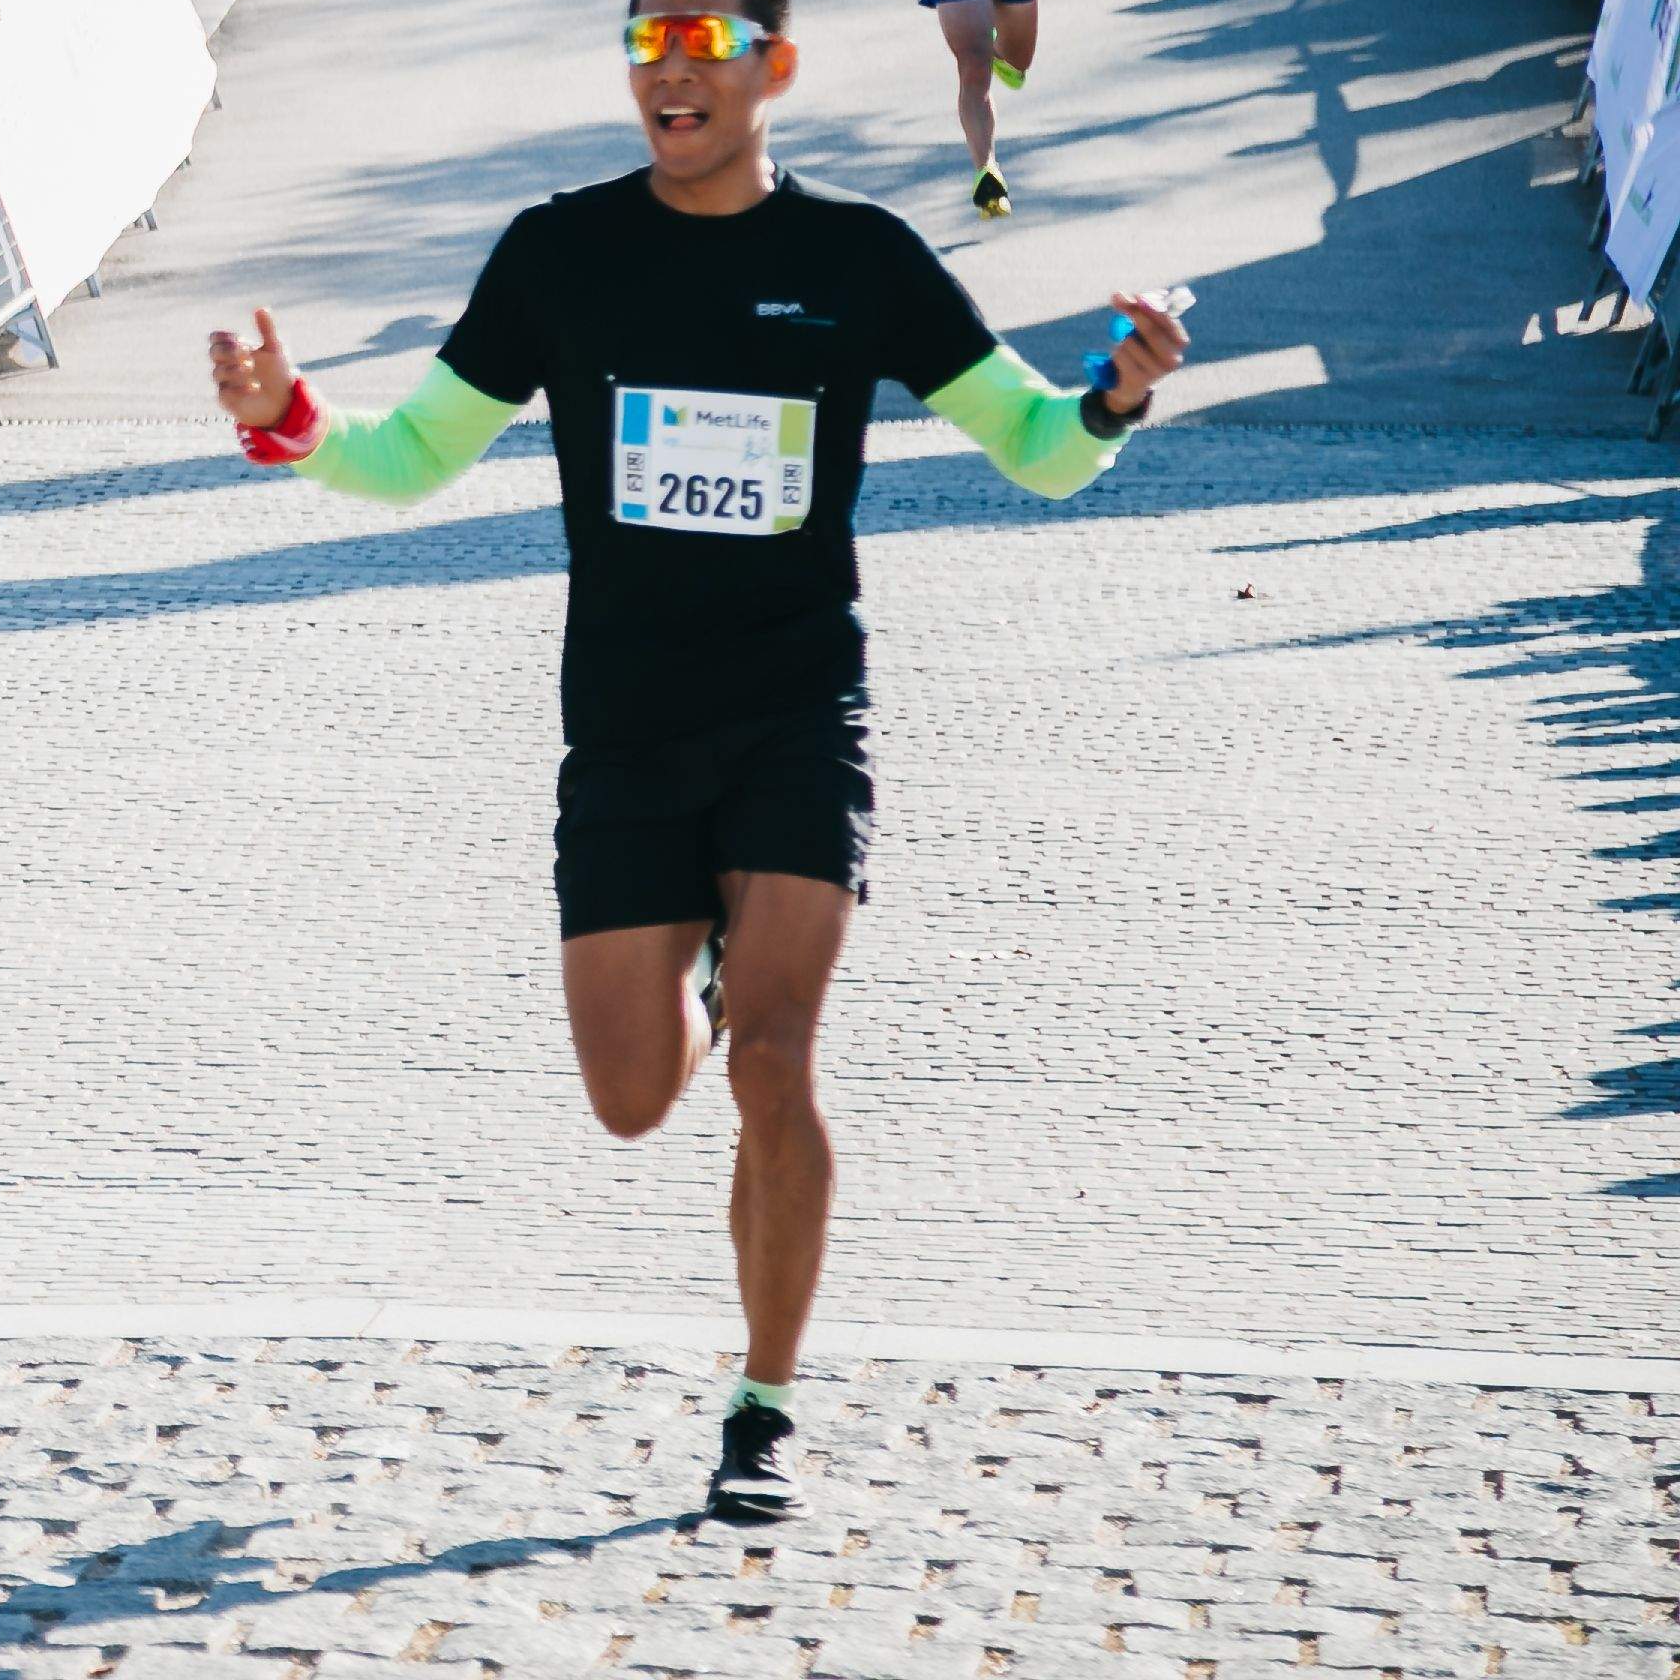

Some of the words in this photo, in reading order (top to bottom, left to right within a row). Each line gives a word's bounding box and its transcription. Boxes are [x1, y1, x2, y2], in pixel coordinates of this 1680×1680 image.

[755, 302, 805, 316] BBVA
[694, 409, 772, 432] MetLife
[658, 473, 764, 521] 2625
